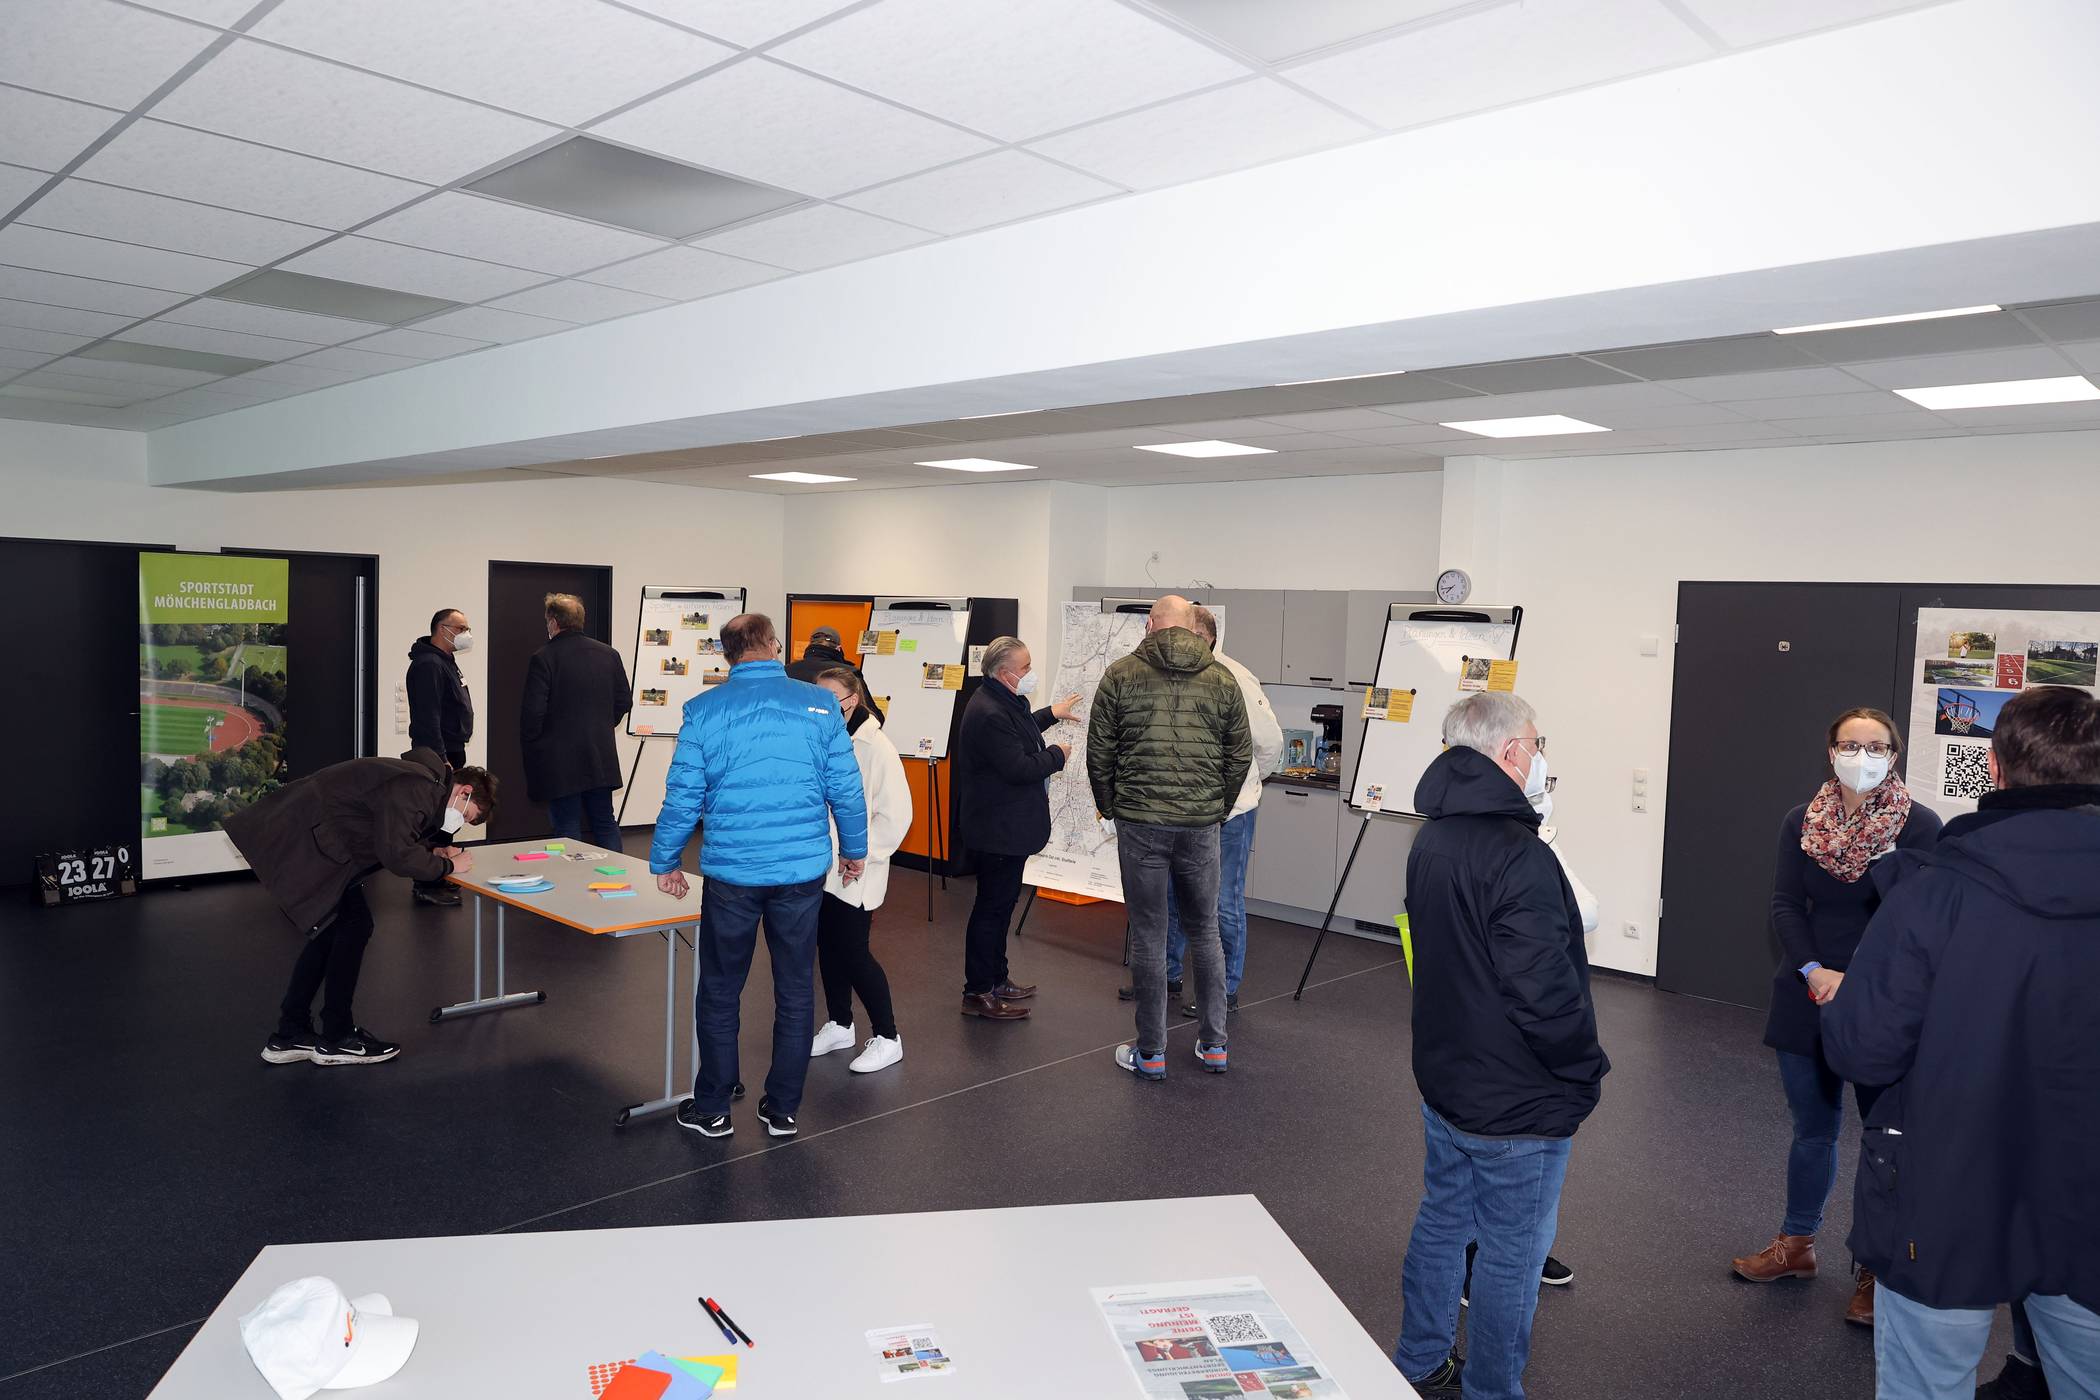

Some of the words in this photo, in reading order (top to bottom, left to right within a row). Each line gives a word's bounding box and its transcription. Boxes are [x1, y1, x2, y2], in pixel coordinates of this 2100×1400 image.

[179, 581, 254, 596] SPORTSTADT
[154, 594, 277, 611] MÖNCHENGLADBACH
[117, 847, 129, 864] 0
[58, 859, 87, 885] 23
[91, 856, 115, 880] 27
[68, 882, 107, 897] JOOLA
[1140, 1306, 1190, 1315] GEFRAGT!
[1148, 1319, 1199, 1327] MEINUNG
[1171, 1326, 1202, 1334] DEINE
